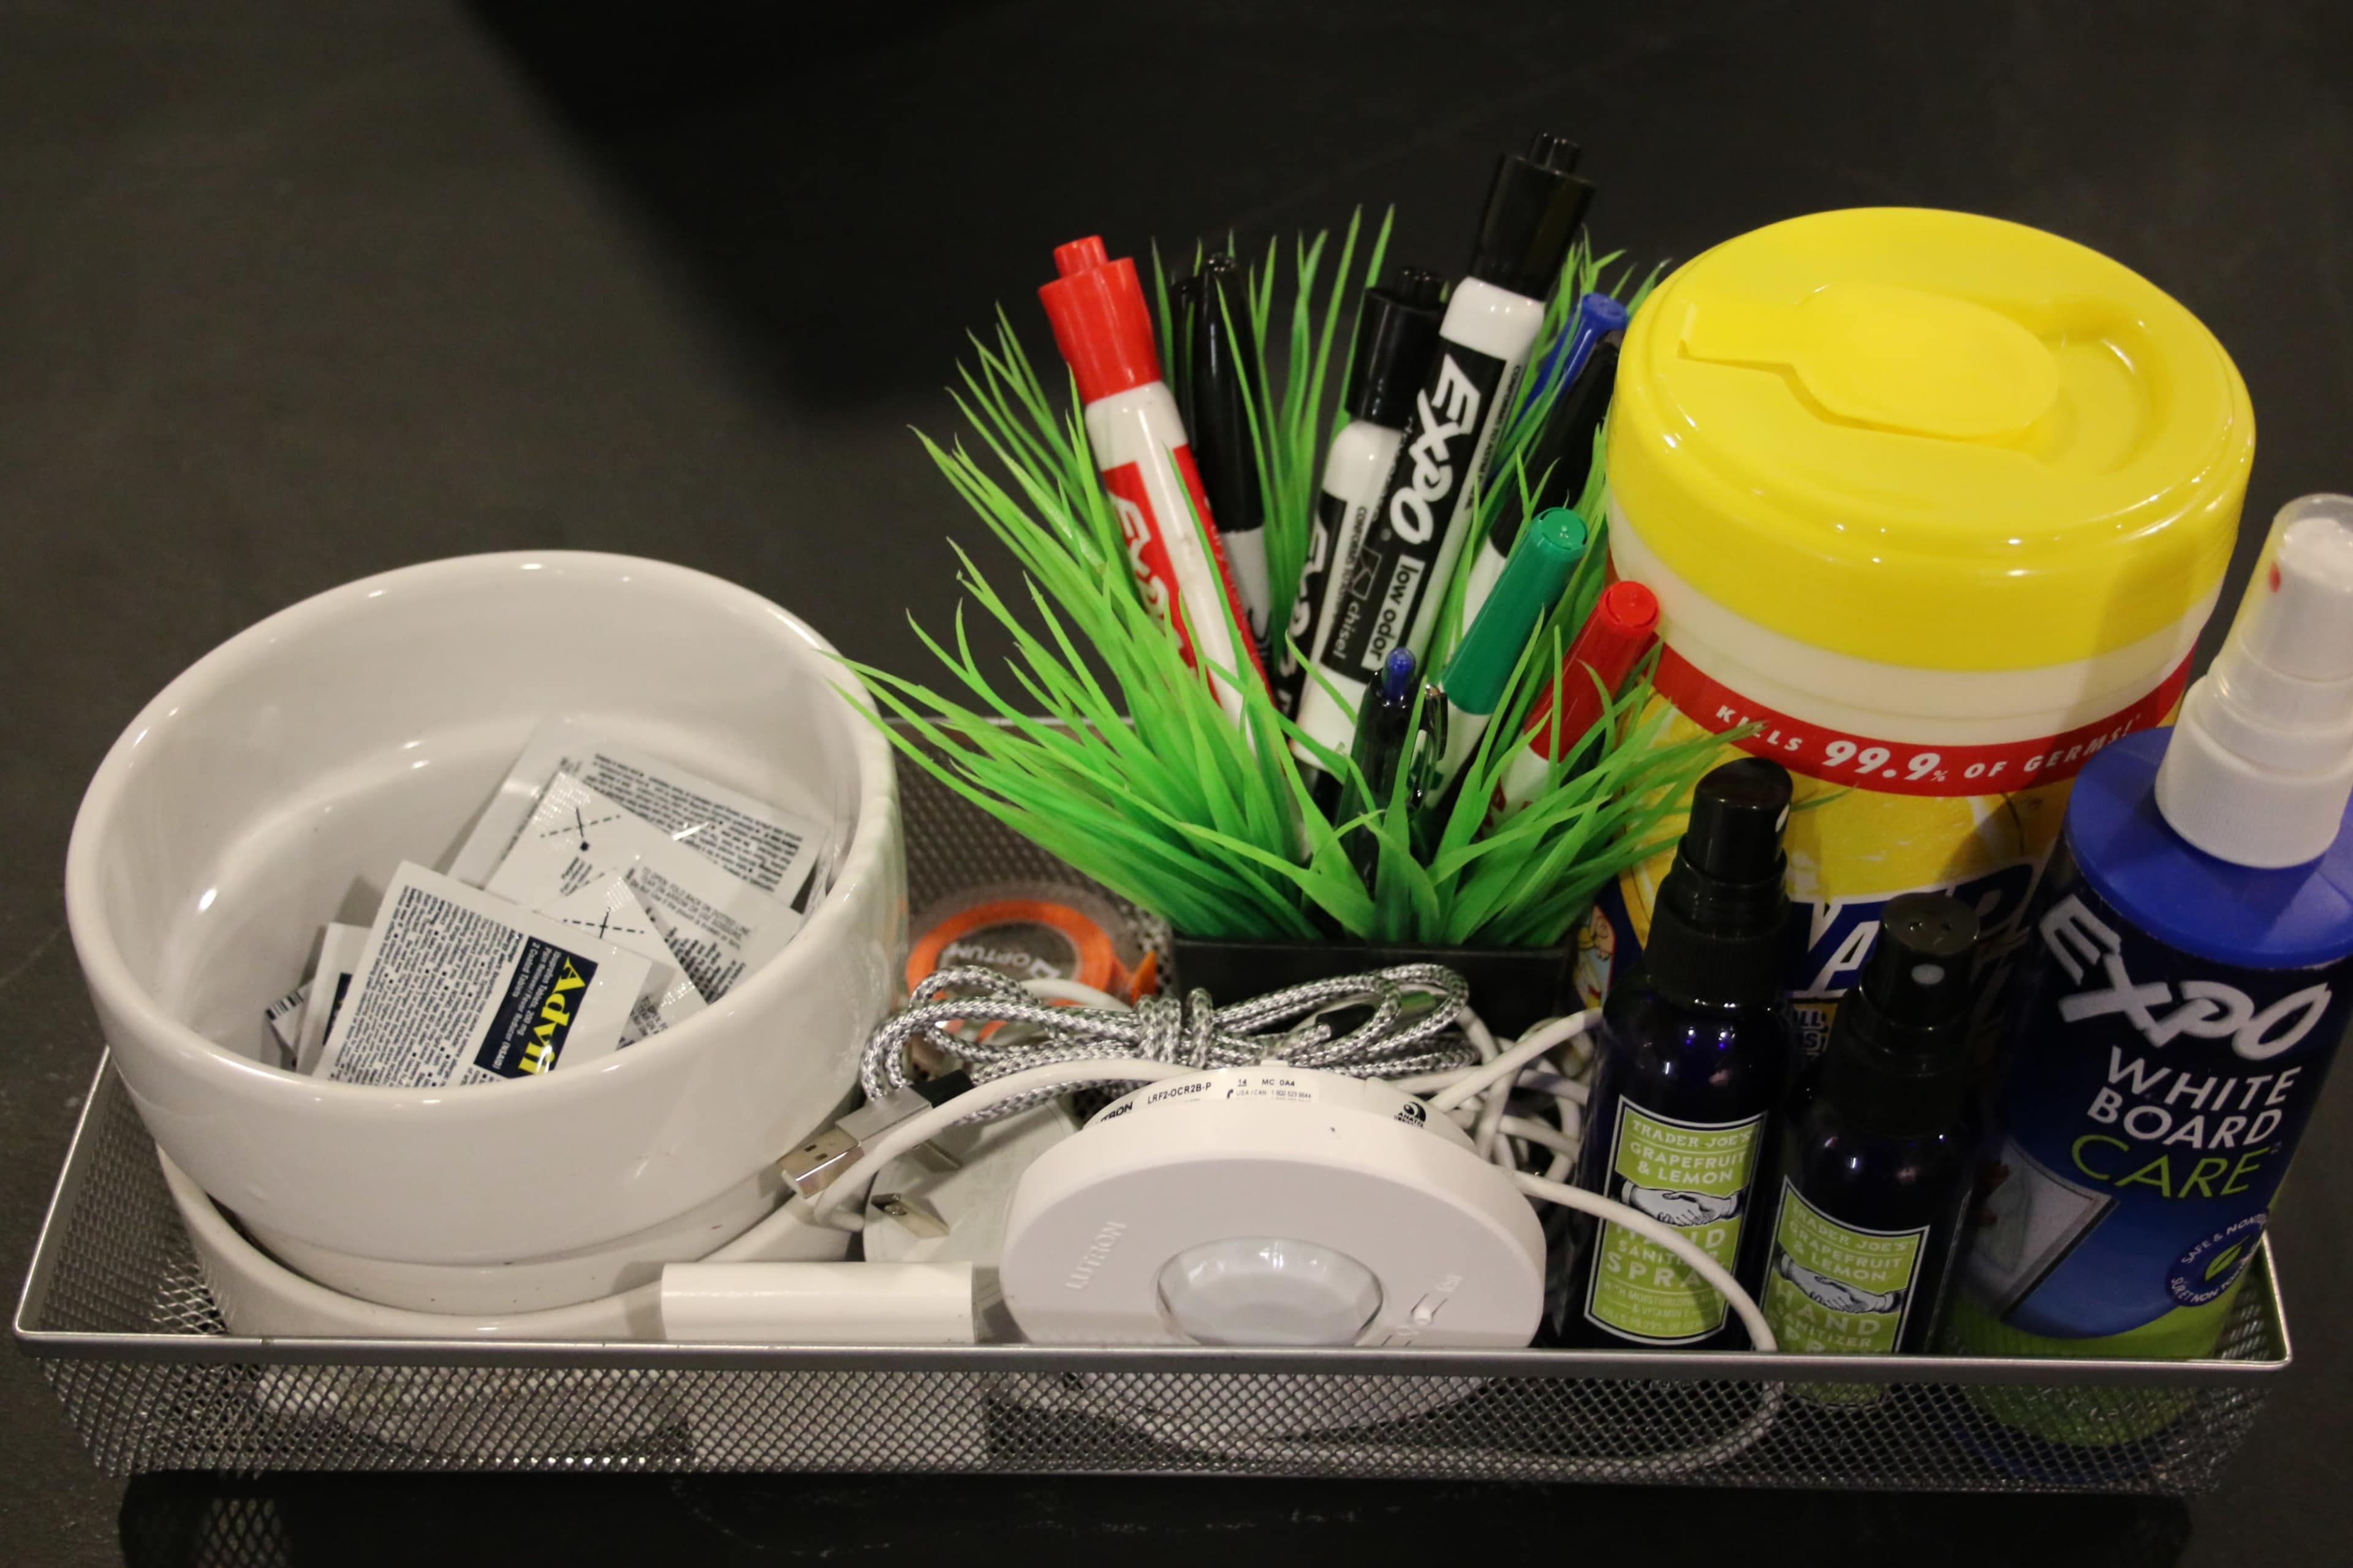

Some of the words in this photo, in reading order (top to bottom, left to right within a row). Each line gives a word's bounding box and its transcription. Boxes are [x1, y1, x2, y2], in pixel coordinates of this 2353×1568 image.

[1390, 353, 1482, 548] EXPO
[1390, 564, 1422, 608] low
[1332, 600, 1362, 659] chisel
[1370, 605, 1406, 662] odor
[1716, 705, 1802, 753] KILS
[1963, 760, 2007, 779] OF
[521, 947, 538, 973] Coated
[539, 946, 552, 964] Pain
[539, 949, 562, 985] Ibuprofen
[510, 972, 528, 999] Tablets
[2039, 893, 2332, 1061] EXPO
[504, 1012, 523, 1042] Reducer
[515, 1023, 529, 1037] mg
[518, 956, 588, 1076] Advil
[523, 1009, 536, 1025] 200
[1147, 1081, 1212, 1105] LRF2-OCR2B-P
[2108, 1045, 2302, 1111] WHITE
[1632, 1119, 1699, 1148] TRADER
[2087, 1086, 2283, 1149] BOARD
[1630, 1141, 1746, 1169] GRAPEFRUIT
[1637, 1161, 1650, 1175] &
[1657, 1167, 1733, 1184] LEMON
[2071, 1134, 2272, 1199] CARE
[1064, 1221, 1127, 1289] LUTRON
[1618, 1240, 1718, 1266] SANITI
[1789, 1219, 1903, 1269] GRAPEFRUIT
[2181, 1240, 2211, 1263] SAFE
[1606, 1251, 1707, 1289] SPRA
[1811, 1251, 1887, 1282] LEMON
[1776, 1282, 1881, 1335] HAND
